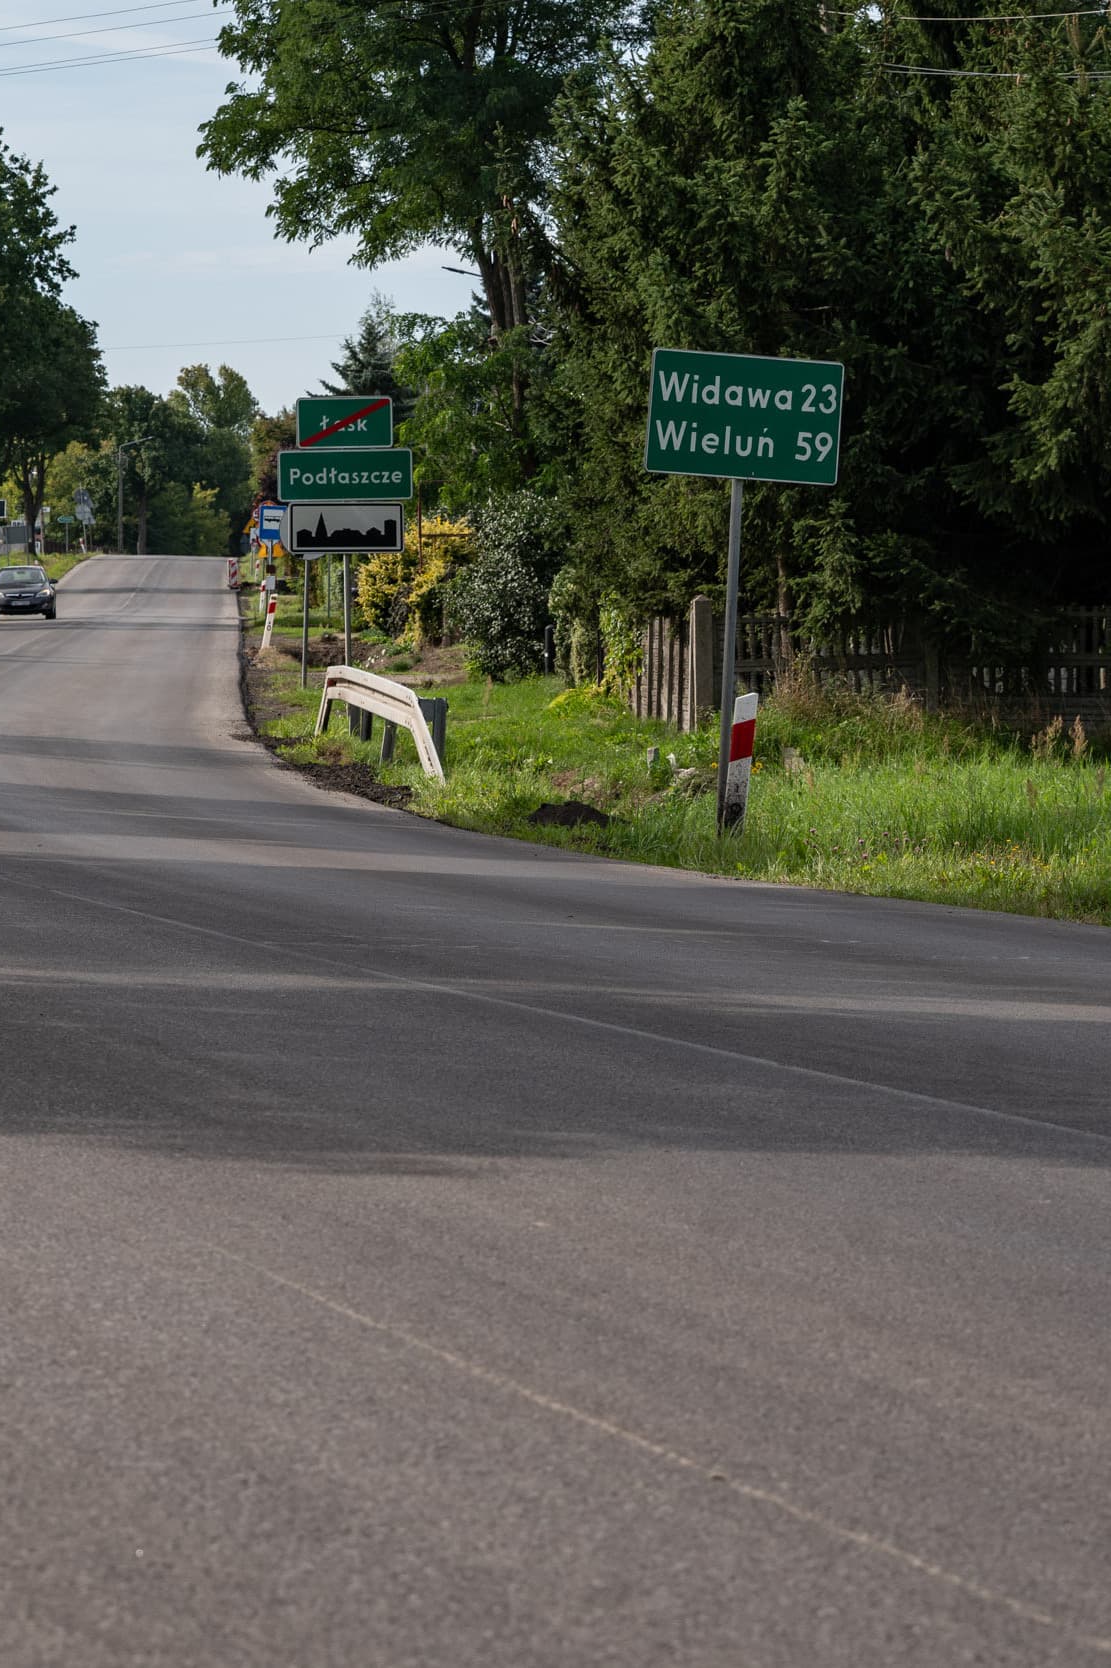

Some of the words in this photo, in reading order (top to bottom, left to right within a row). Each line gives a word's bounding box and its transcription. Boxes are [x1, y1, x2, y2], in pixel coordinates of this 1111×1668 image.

[658, 370, 793, 411] Widawa
[800, 383, 838, 415] 23
[655, 419, 775, 459] Wieluń
[794, 431, 834, 463] 59
[289, 466, 403, 486] Podłaszcze
